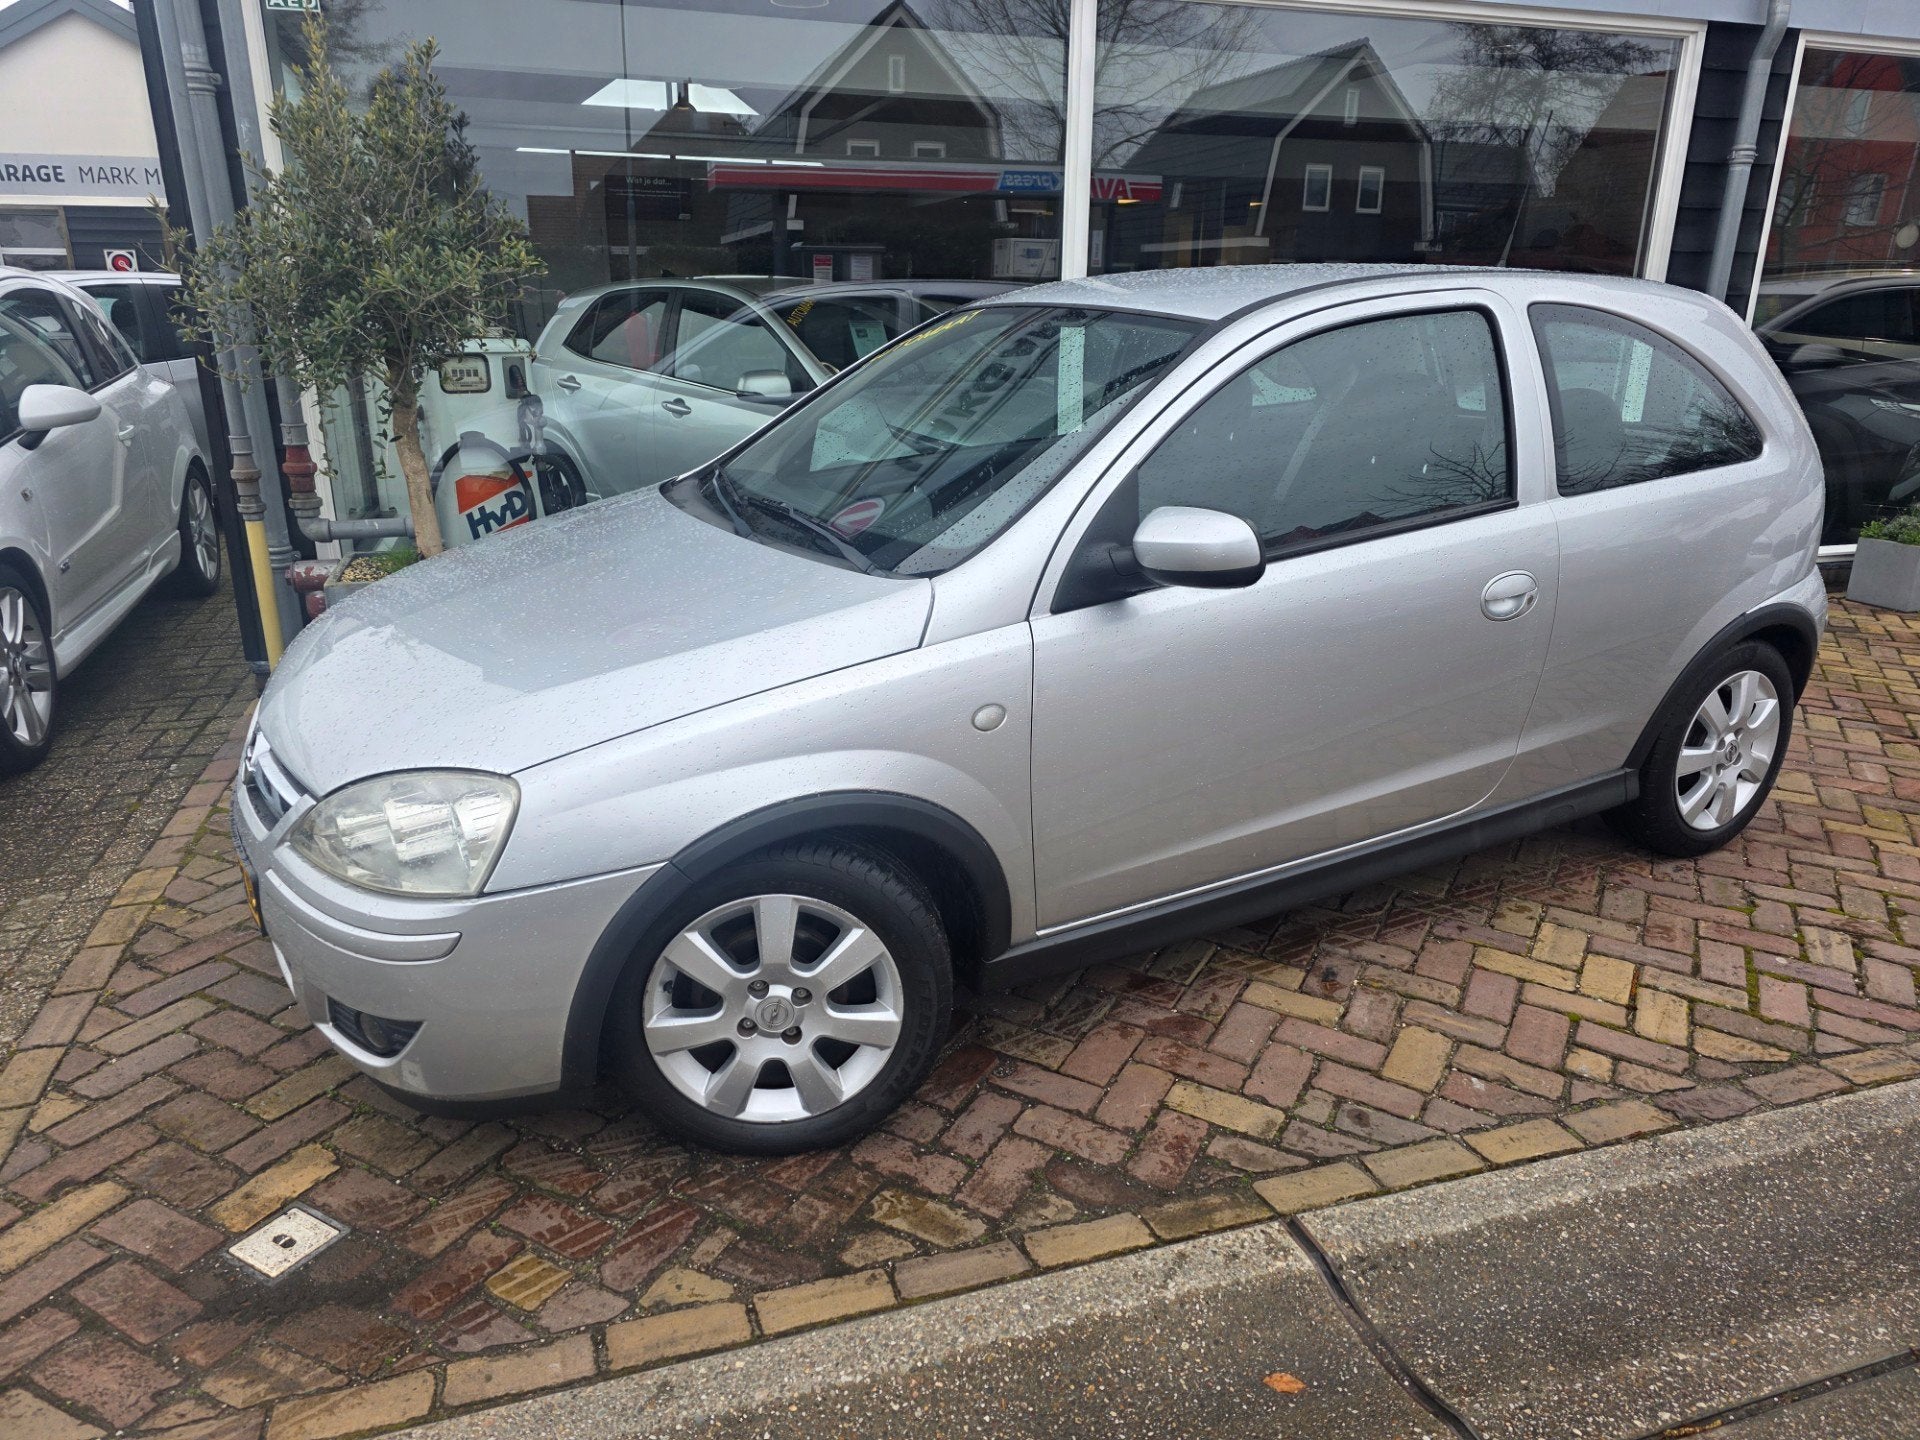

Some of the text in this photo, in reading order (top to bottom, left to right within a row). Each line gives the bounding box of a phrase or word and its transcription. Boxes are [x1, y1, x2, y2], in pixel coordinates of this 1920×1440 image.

[78, 166, 138, 185] MARK
[466, 491, 527, 540] HvD
[879, 976, 933, 1104] FEDERAL
